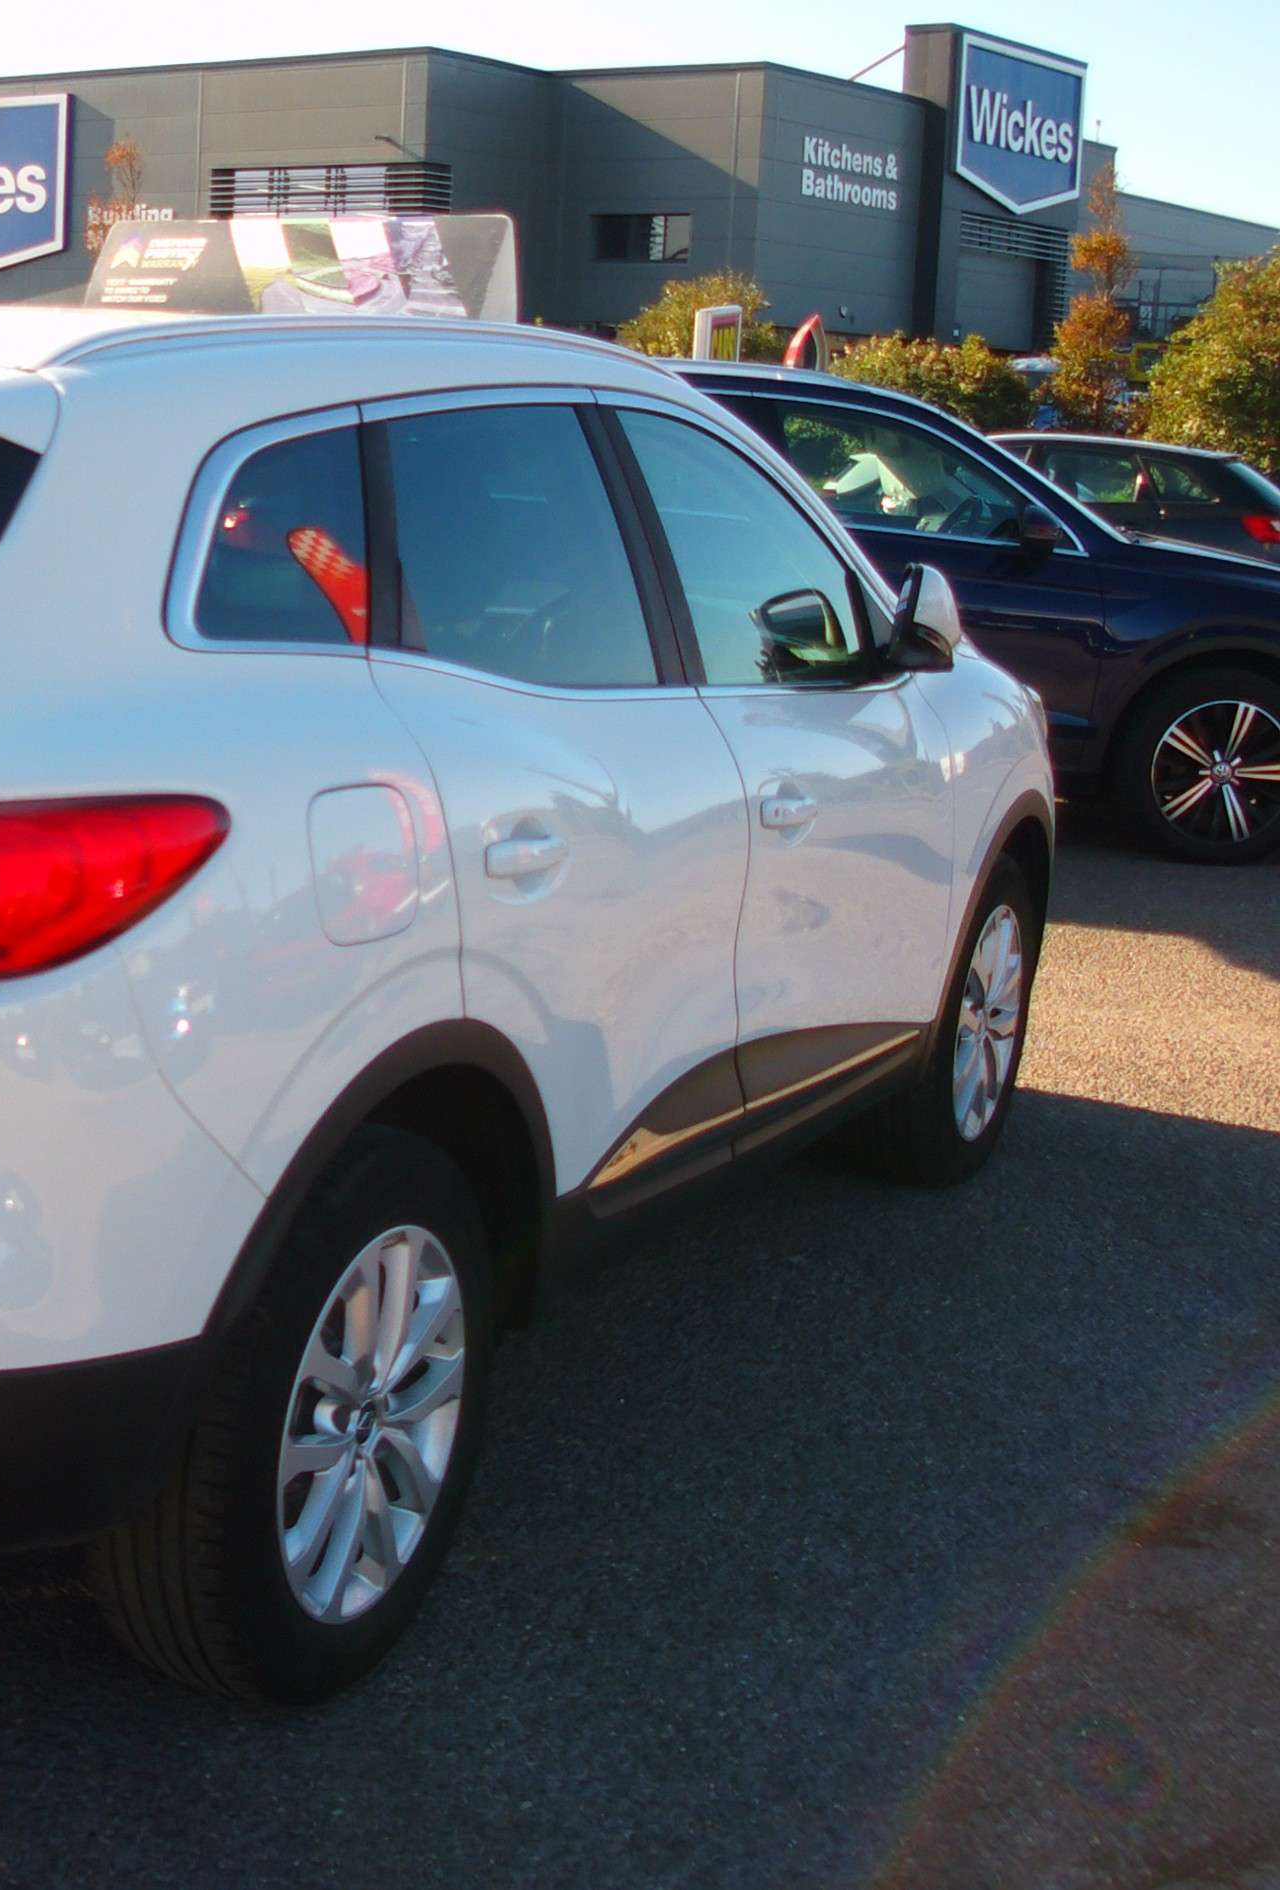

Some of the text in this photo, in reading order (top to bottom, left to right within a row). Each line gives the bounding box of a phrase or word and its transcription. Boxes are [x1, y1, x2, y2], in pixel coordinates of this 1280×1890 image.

[970, 84, 1073, 165] Wickes
[804, 136, 898, 181] Kitchens &
[801, 168, 897, 211] Bathrooms
